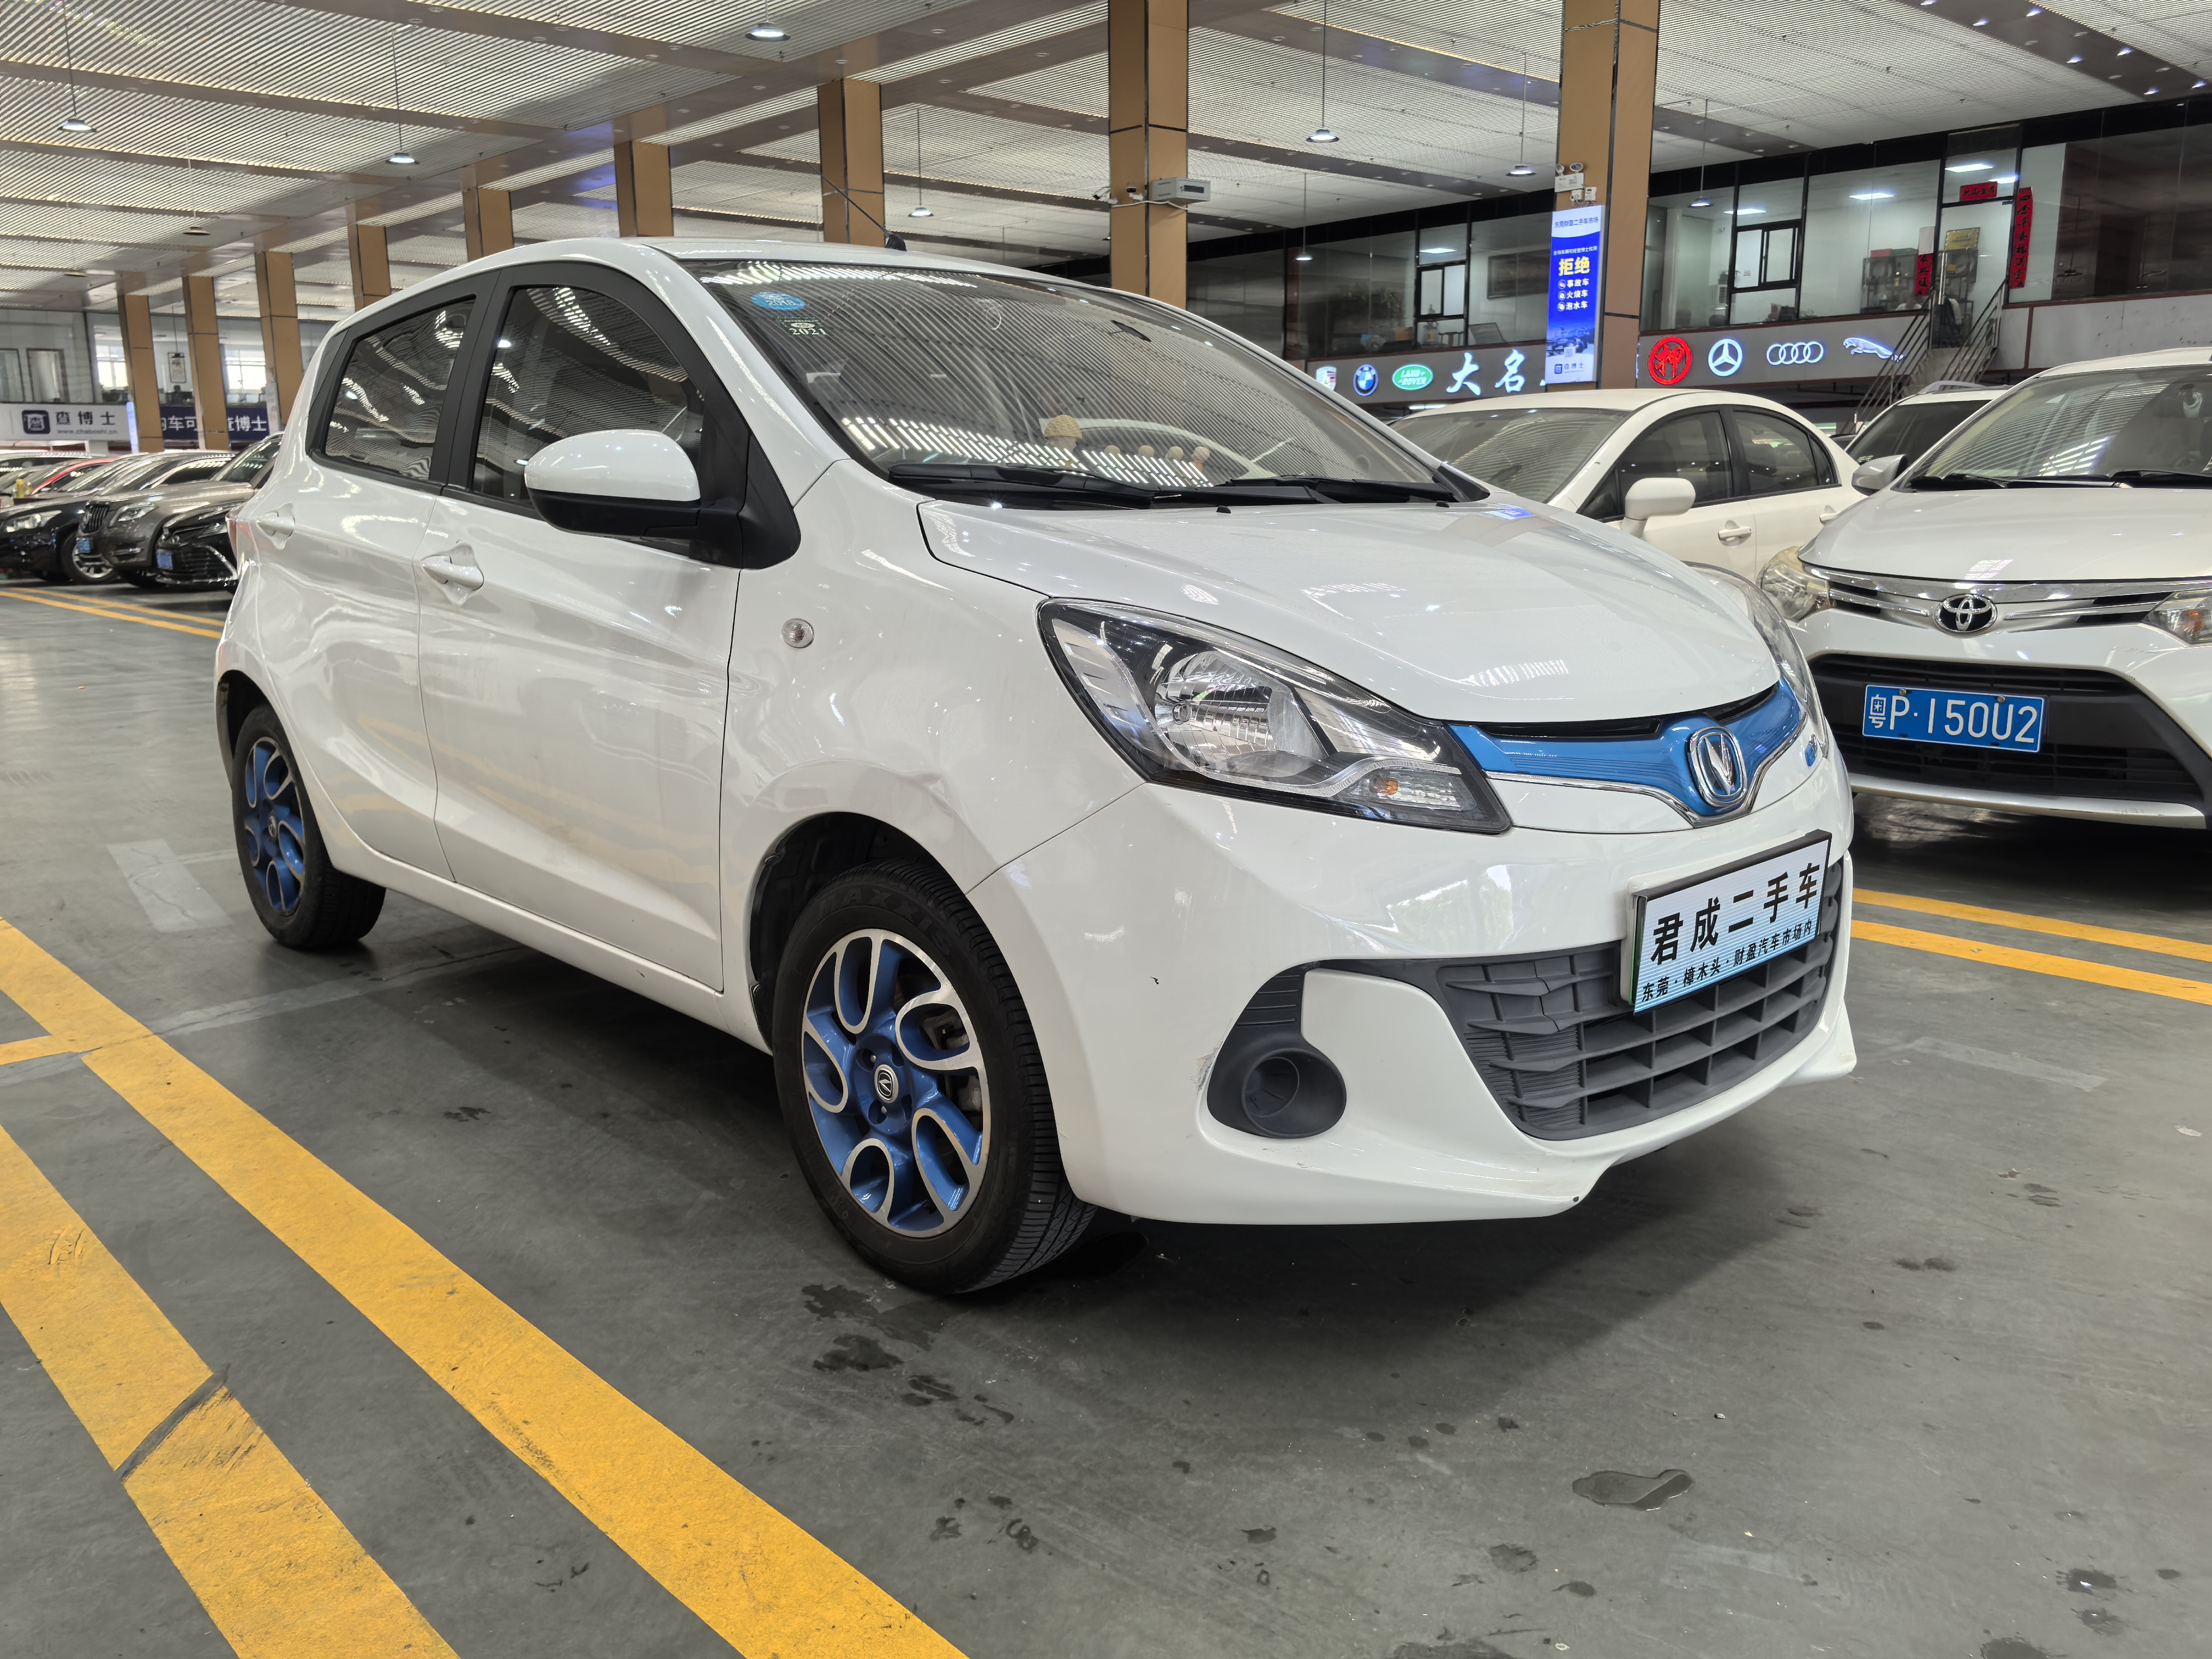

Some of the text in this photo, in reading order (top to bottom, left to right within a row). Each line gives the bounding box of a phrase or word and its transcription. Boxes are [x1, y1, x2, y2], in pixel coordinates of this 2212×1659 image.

[1558, 255, 1590, 276] 拒绝
[1567, 278, 1590, 288] 事故车
[1566, 289, 1589, 299] 火烧车
[1566, 300, 1588, 310] 泡水车
[1655, 343, 1685, 378] 押
[1401, 377, 1427, 386] ROVER
[1446, 349, 1546, 396] 大名
[55, 410, 116, 426] 查博士
[816, 888, 951, 956] MAXXIS
[1650, 862, 1821, 966] 君成二手车
[1641, 918, 1812, 1003] 东莞·樟木头·财盈汽车市场内
